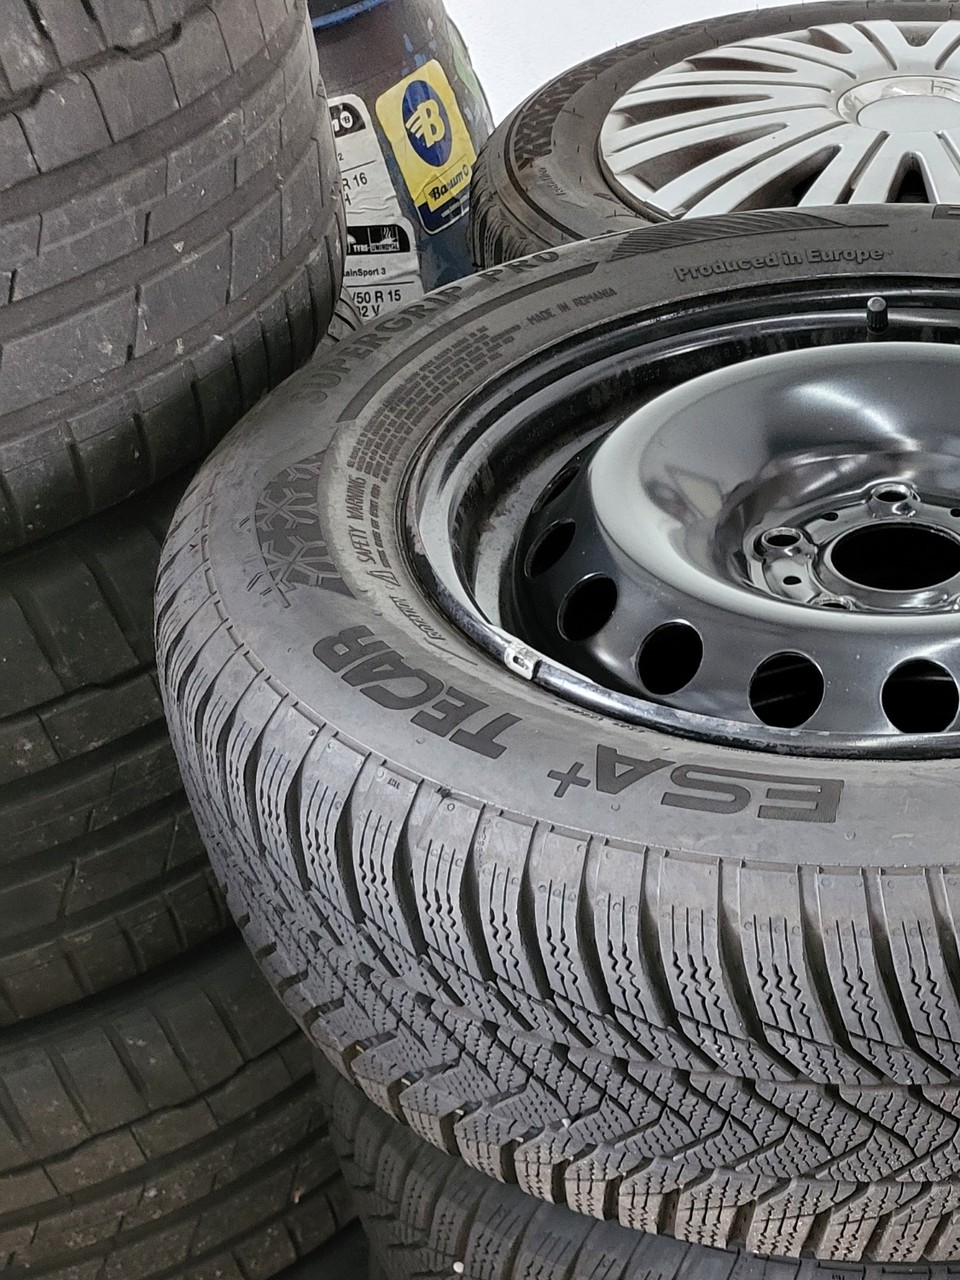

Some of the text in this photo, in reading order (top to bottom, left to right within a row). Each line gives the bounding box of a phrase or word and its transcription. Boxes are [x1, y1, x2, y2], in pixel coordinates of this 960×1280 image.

[353, 172, 368, 188] 16
[343, 267, 386, 278] ainSport 3
[674, 248, 885, 283] Produced in Europe
[371, 305, 380, 317] V
[375, 291, 384, 303] R
[387, 289, 402, 302] 15
[527, 287, 618, 326] MADE IN ROMANIA
[300, 285, 463, 404] SUPERGRIP
[479, 251, 559, 285] PRO
[345, 475, 377, 565] SAFETY WARNING
[312, 625, 523, 760] TECAR
[547, 744, 845, 823] ESA+
